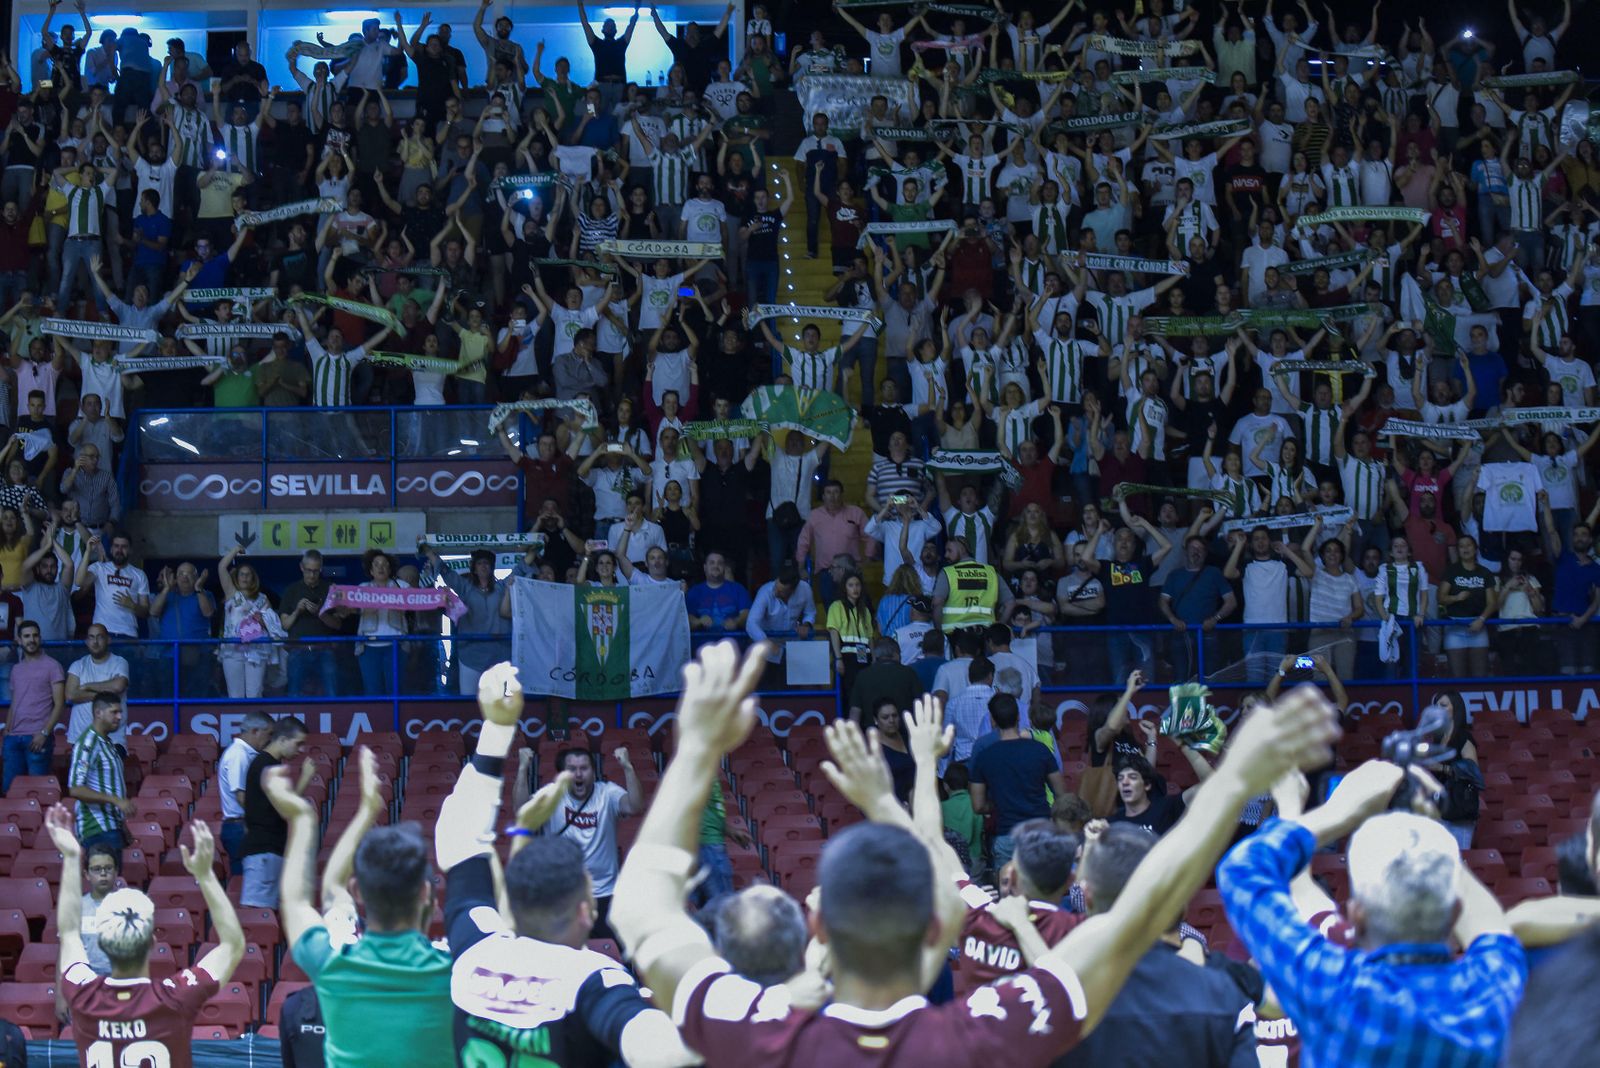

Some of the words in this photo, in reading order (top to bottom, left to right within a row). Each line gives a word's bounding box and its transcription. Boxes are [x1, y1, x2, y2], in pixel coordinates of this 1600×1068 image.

[1067, 113, 1121, 128] CORDOBA
[876, 128, 927, 138] CORDOB
[1232, 178, 1260, 188] NASA
[627, 242, 689, 254] CÓRDOBA
[1114, 258, 1135, 269] CRUZ
[1137, 260, 1168, 272] CONDE
[270, 473, 386, 496] SEVILLA
[956, 569, 987, 578] Trablisa
[347, 588, 405, 604] CÓRDOBA
[407, 593, 442, 605] GIRLS
[965, 596, 979, 607] 173
[549, 665, 655, 687] CÓRDOBA
[964, 936, 1020, 971] DAVID
[98, 1019, 147, 1039] KEKO
